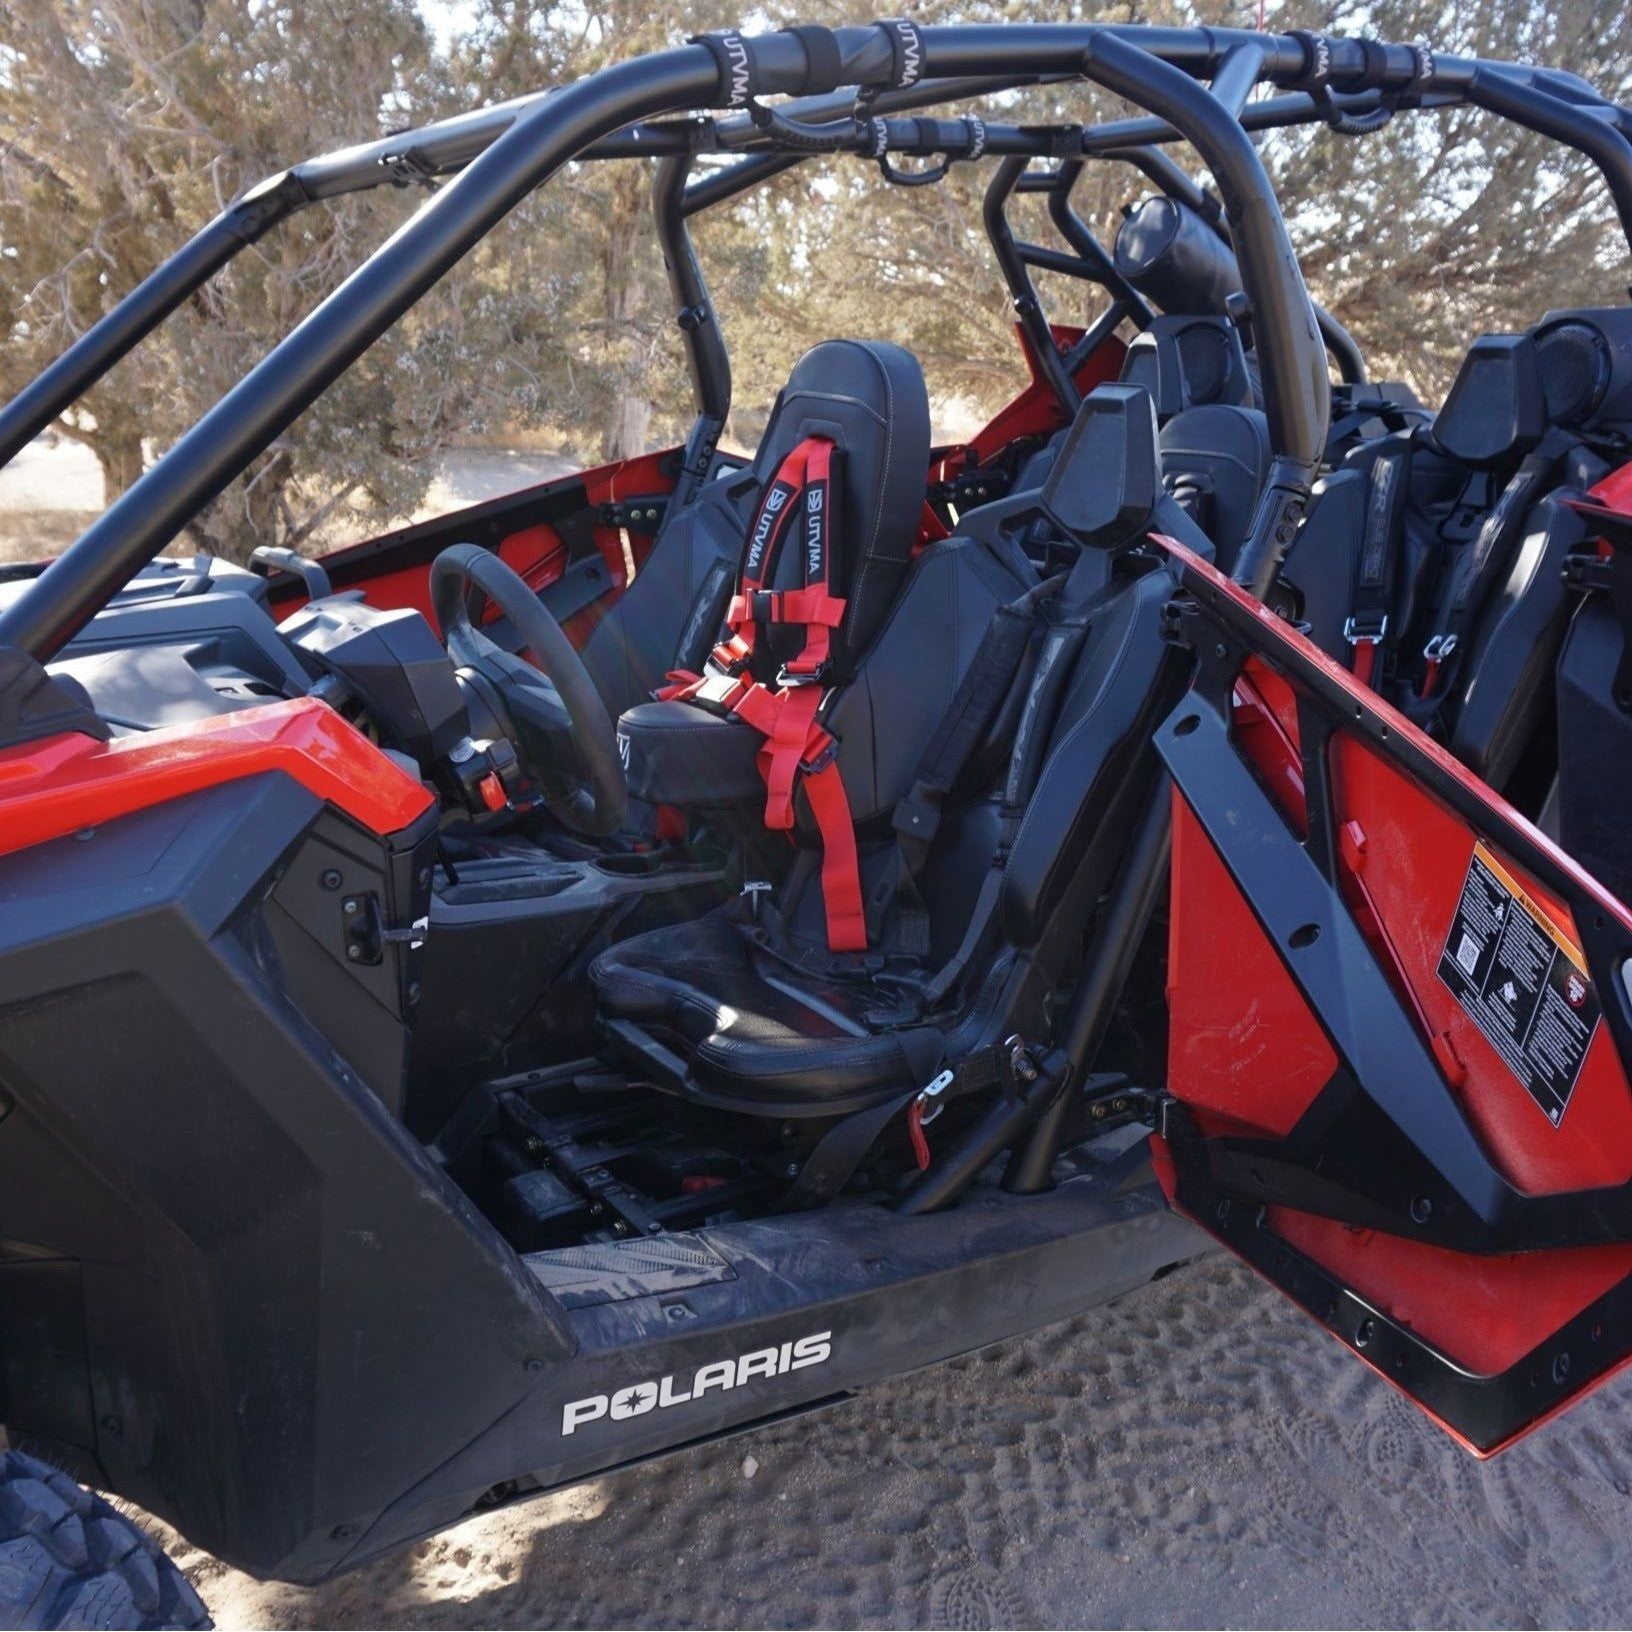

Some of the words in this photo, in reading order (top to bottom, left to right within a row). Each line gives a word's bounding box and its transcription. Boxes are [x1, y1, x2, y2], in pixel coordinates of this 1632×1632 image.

[723, 36, 750, 107] UTVMA
[897, 23, 920, 87] UTVMA
[748, 514, 773, 567] UTVMA
[807, 515, 821, 575] UTVMA
[1525, 902, 1555, 937] WARNING
[561, 1330, 832, 1436] POLARIS
